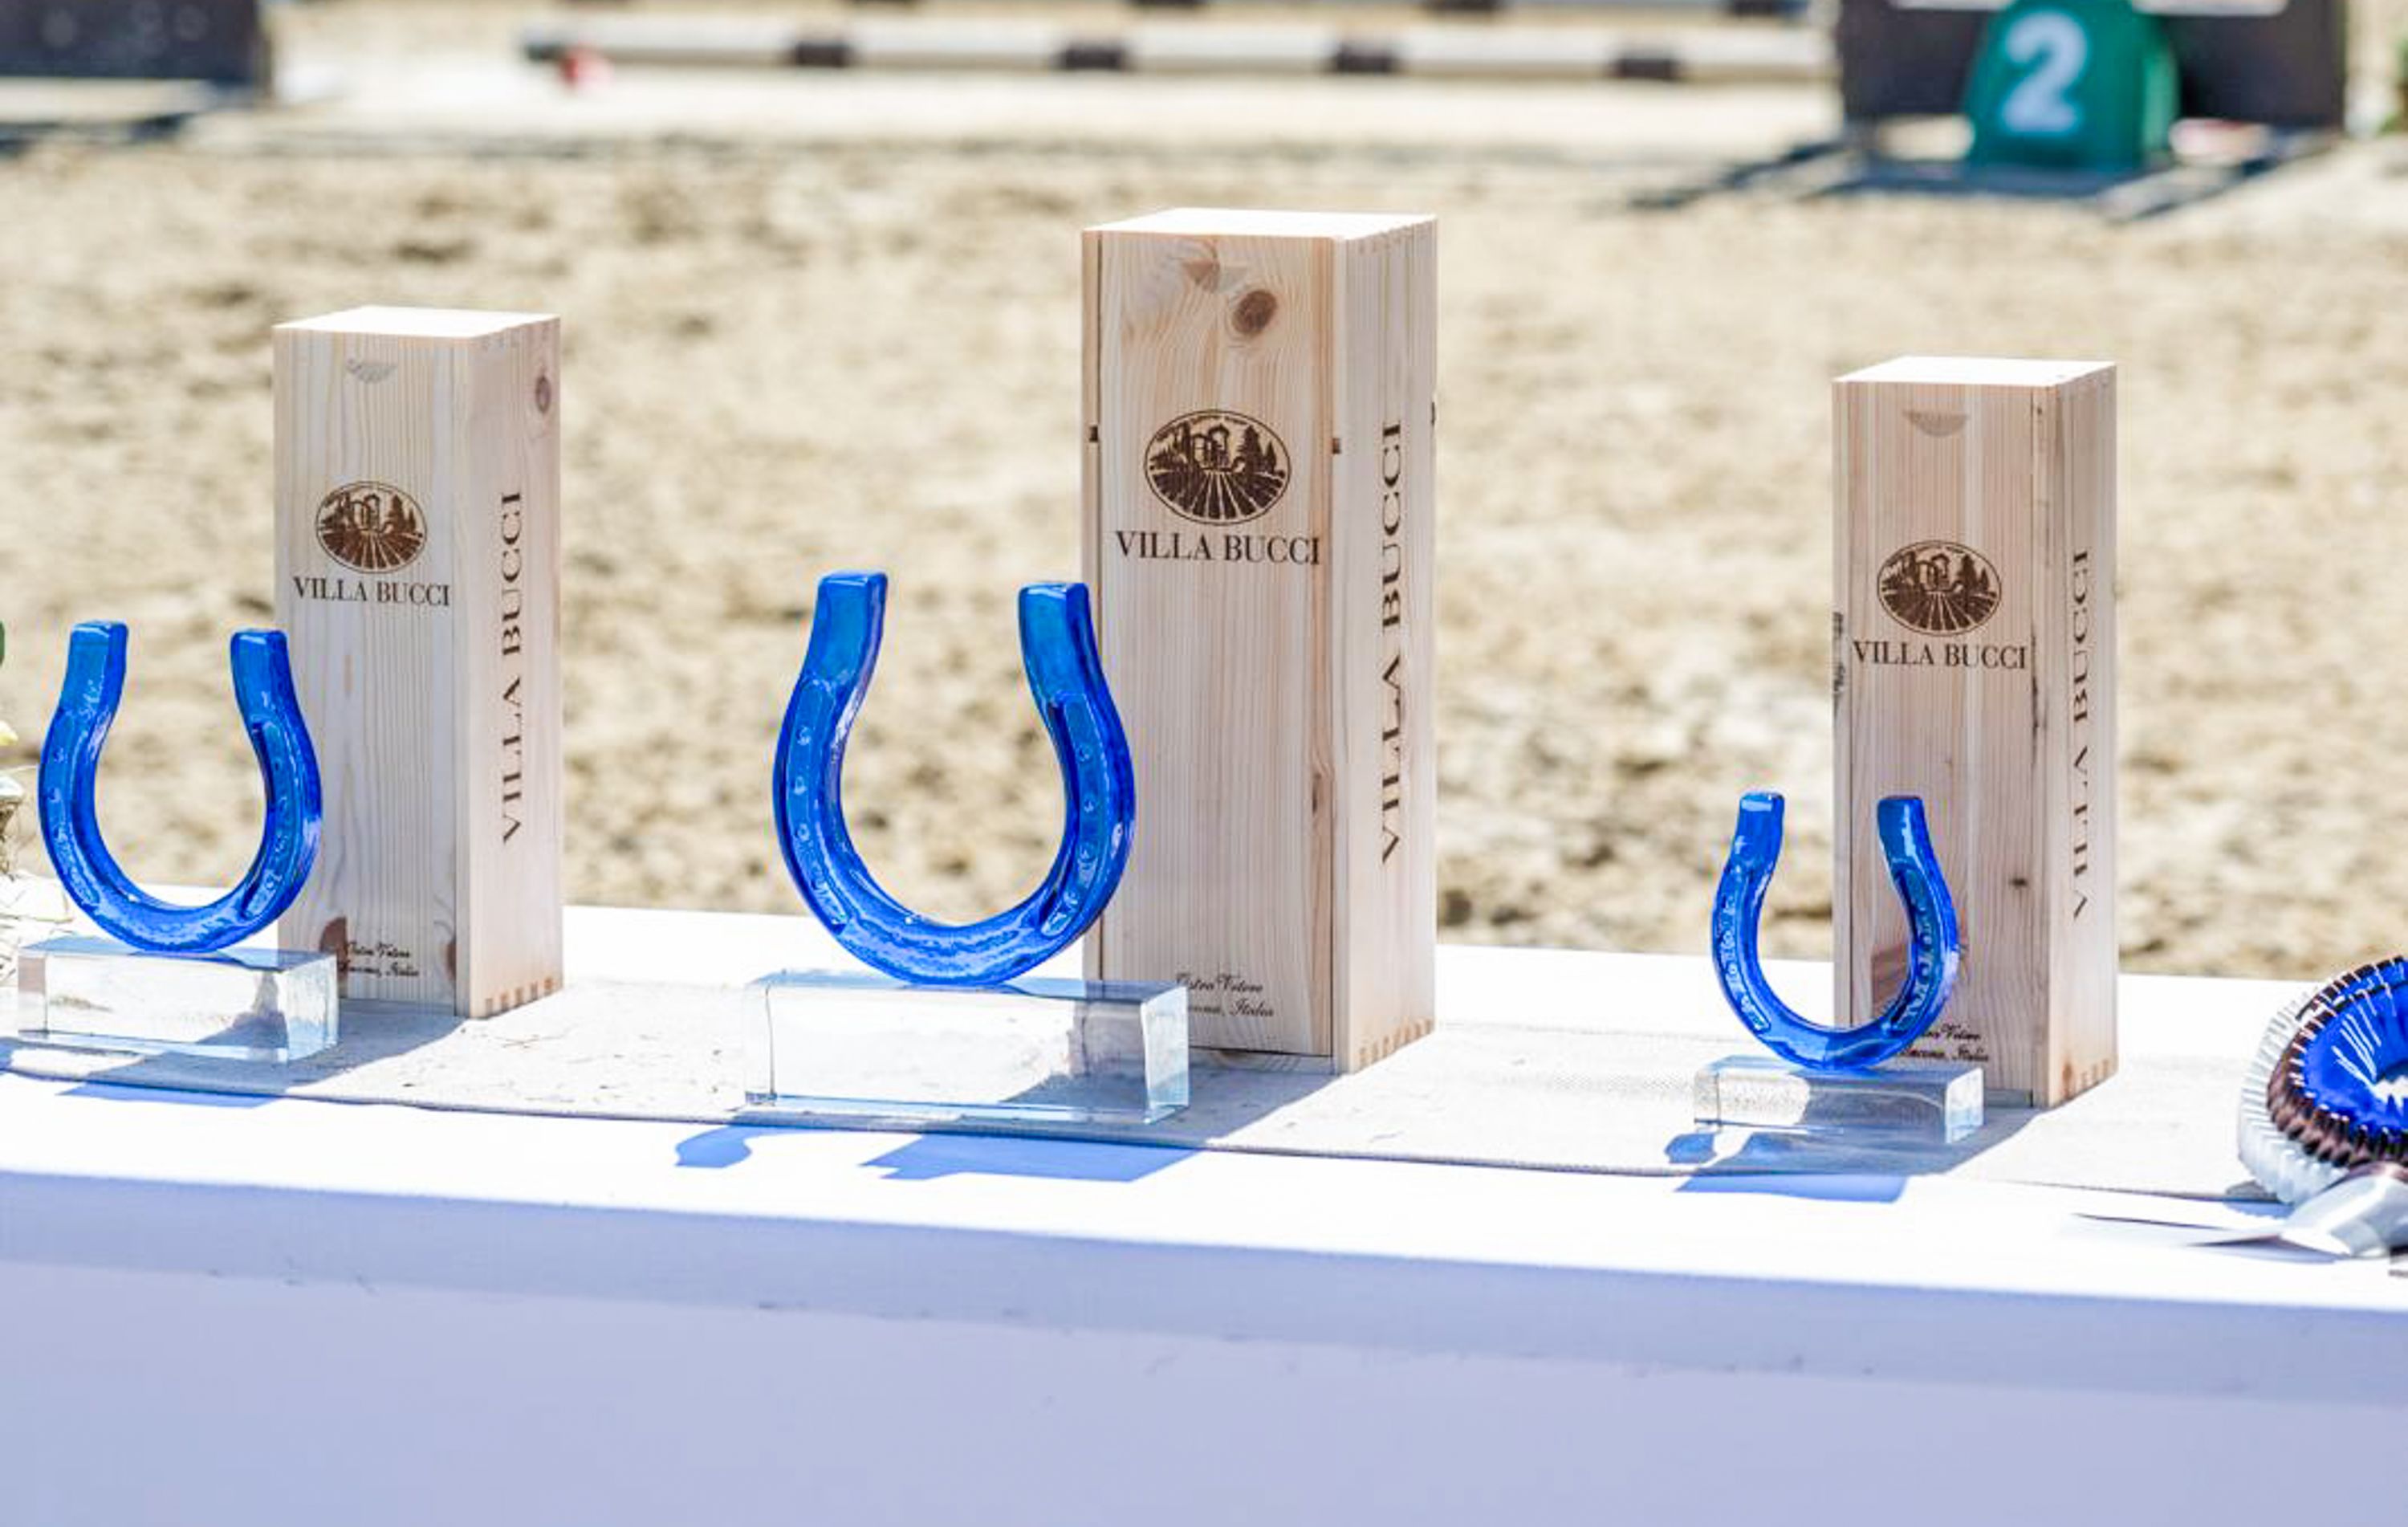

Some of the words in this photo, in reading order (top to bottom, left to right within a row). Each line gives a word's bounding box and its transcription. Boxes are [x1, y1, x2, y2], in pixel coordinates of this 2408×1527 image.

[2003, 10, 2089, 133] 2
[292, 576, 368, 601] VILLA
[376, 580, 450, 607] BUCCI
[501, 491, 522, 658] BUCCI
[1116, 530, 1214, 561] VILLA
[1223, 534, 1320, 565] BUCCI
[1381, 421, 1401, 629] BUCCI
[1853, 640, 1935, 666] VILLA
[1944, 644, 2028, 670] BUCCI
[2072, 549, 2089, 723] BUCCI
[501, 676, 522, 845] VILLA
[1381, 654, 1401, 865] VILLA
[2073, 746, 2089, 920] VILLA
